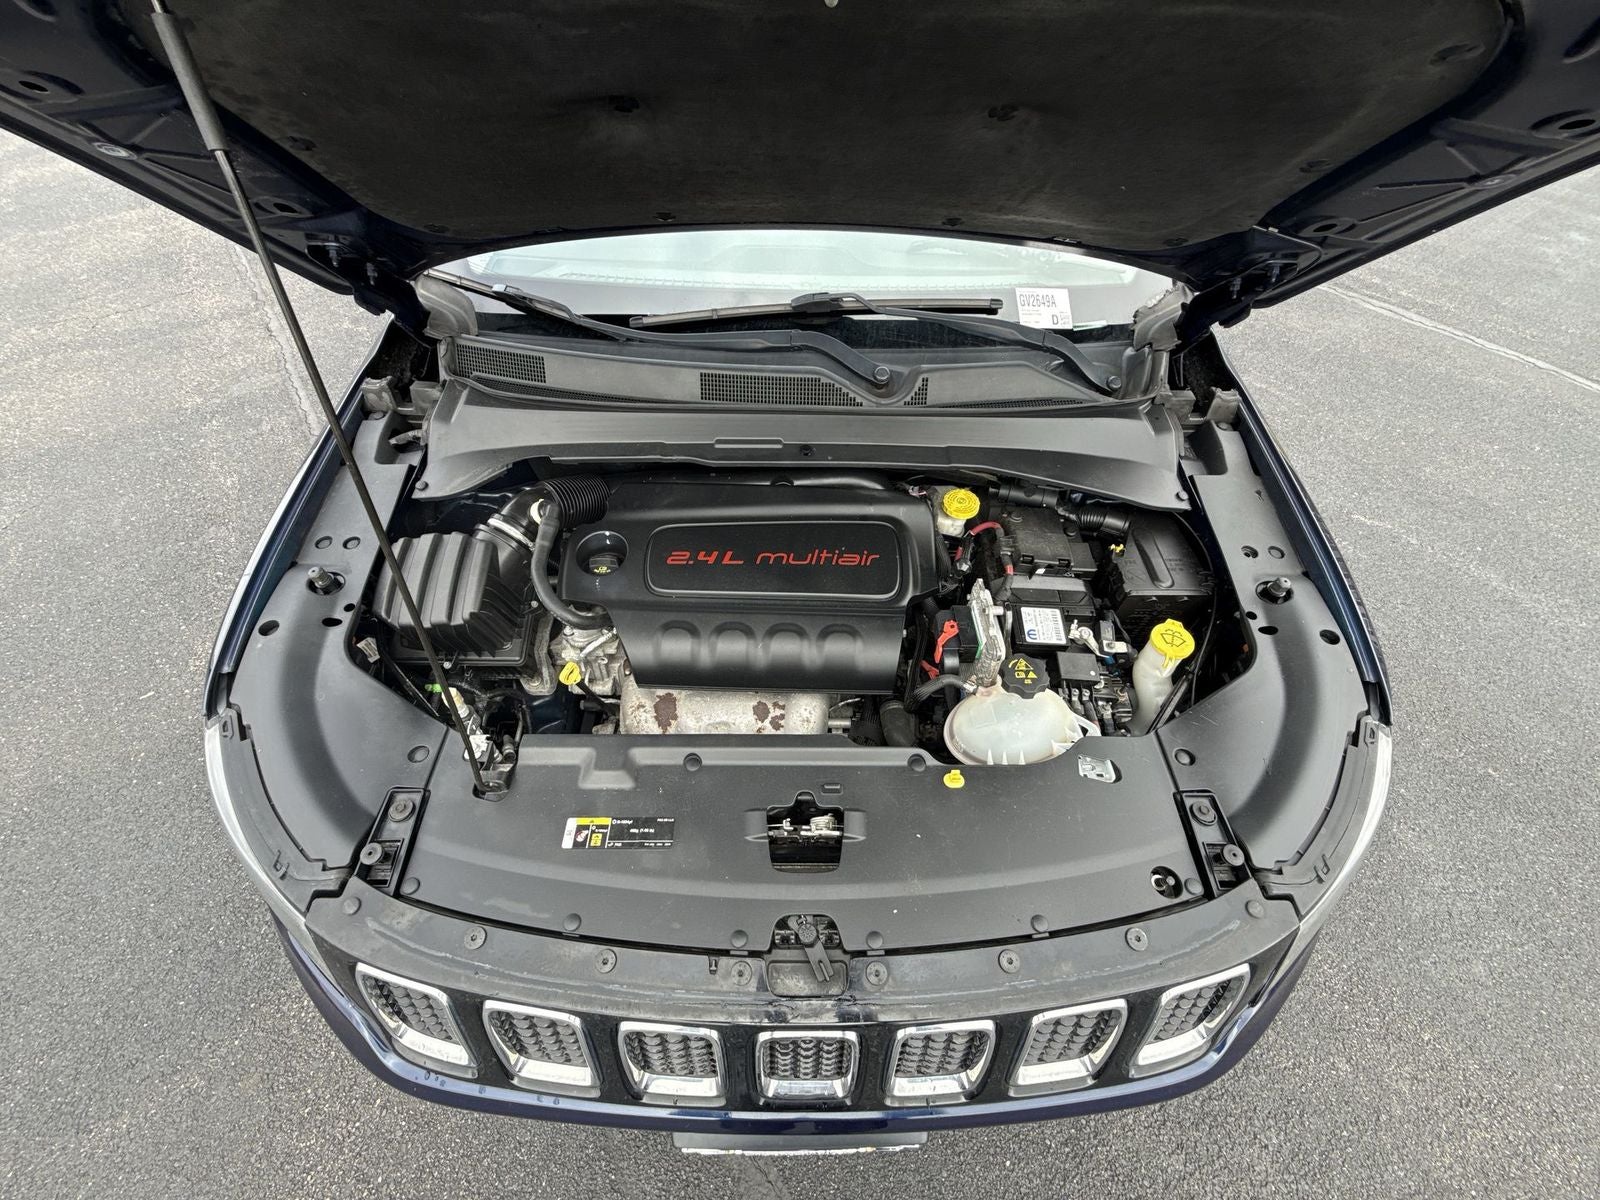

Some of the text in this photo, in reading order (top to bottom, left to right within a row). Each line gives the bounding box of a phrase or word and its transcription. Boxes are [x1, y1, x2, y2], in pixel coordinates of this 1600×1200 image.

[1019, 294, 1057, 308] GV2649A
[1051, 314, 1059, 325] D
[756, 549, 880, 566] multiair
